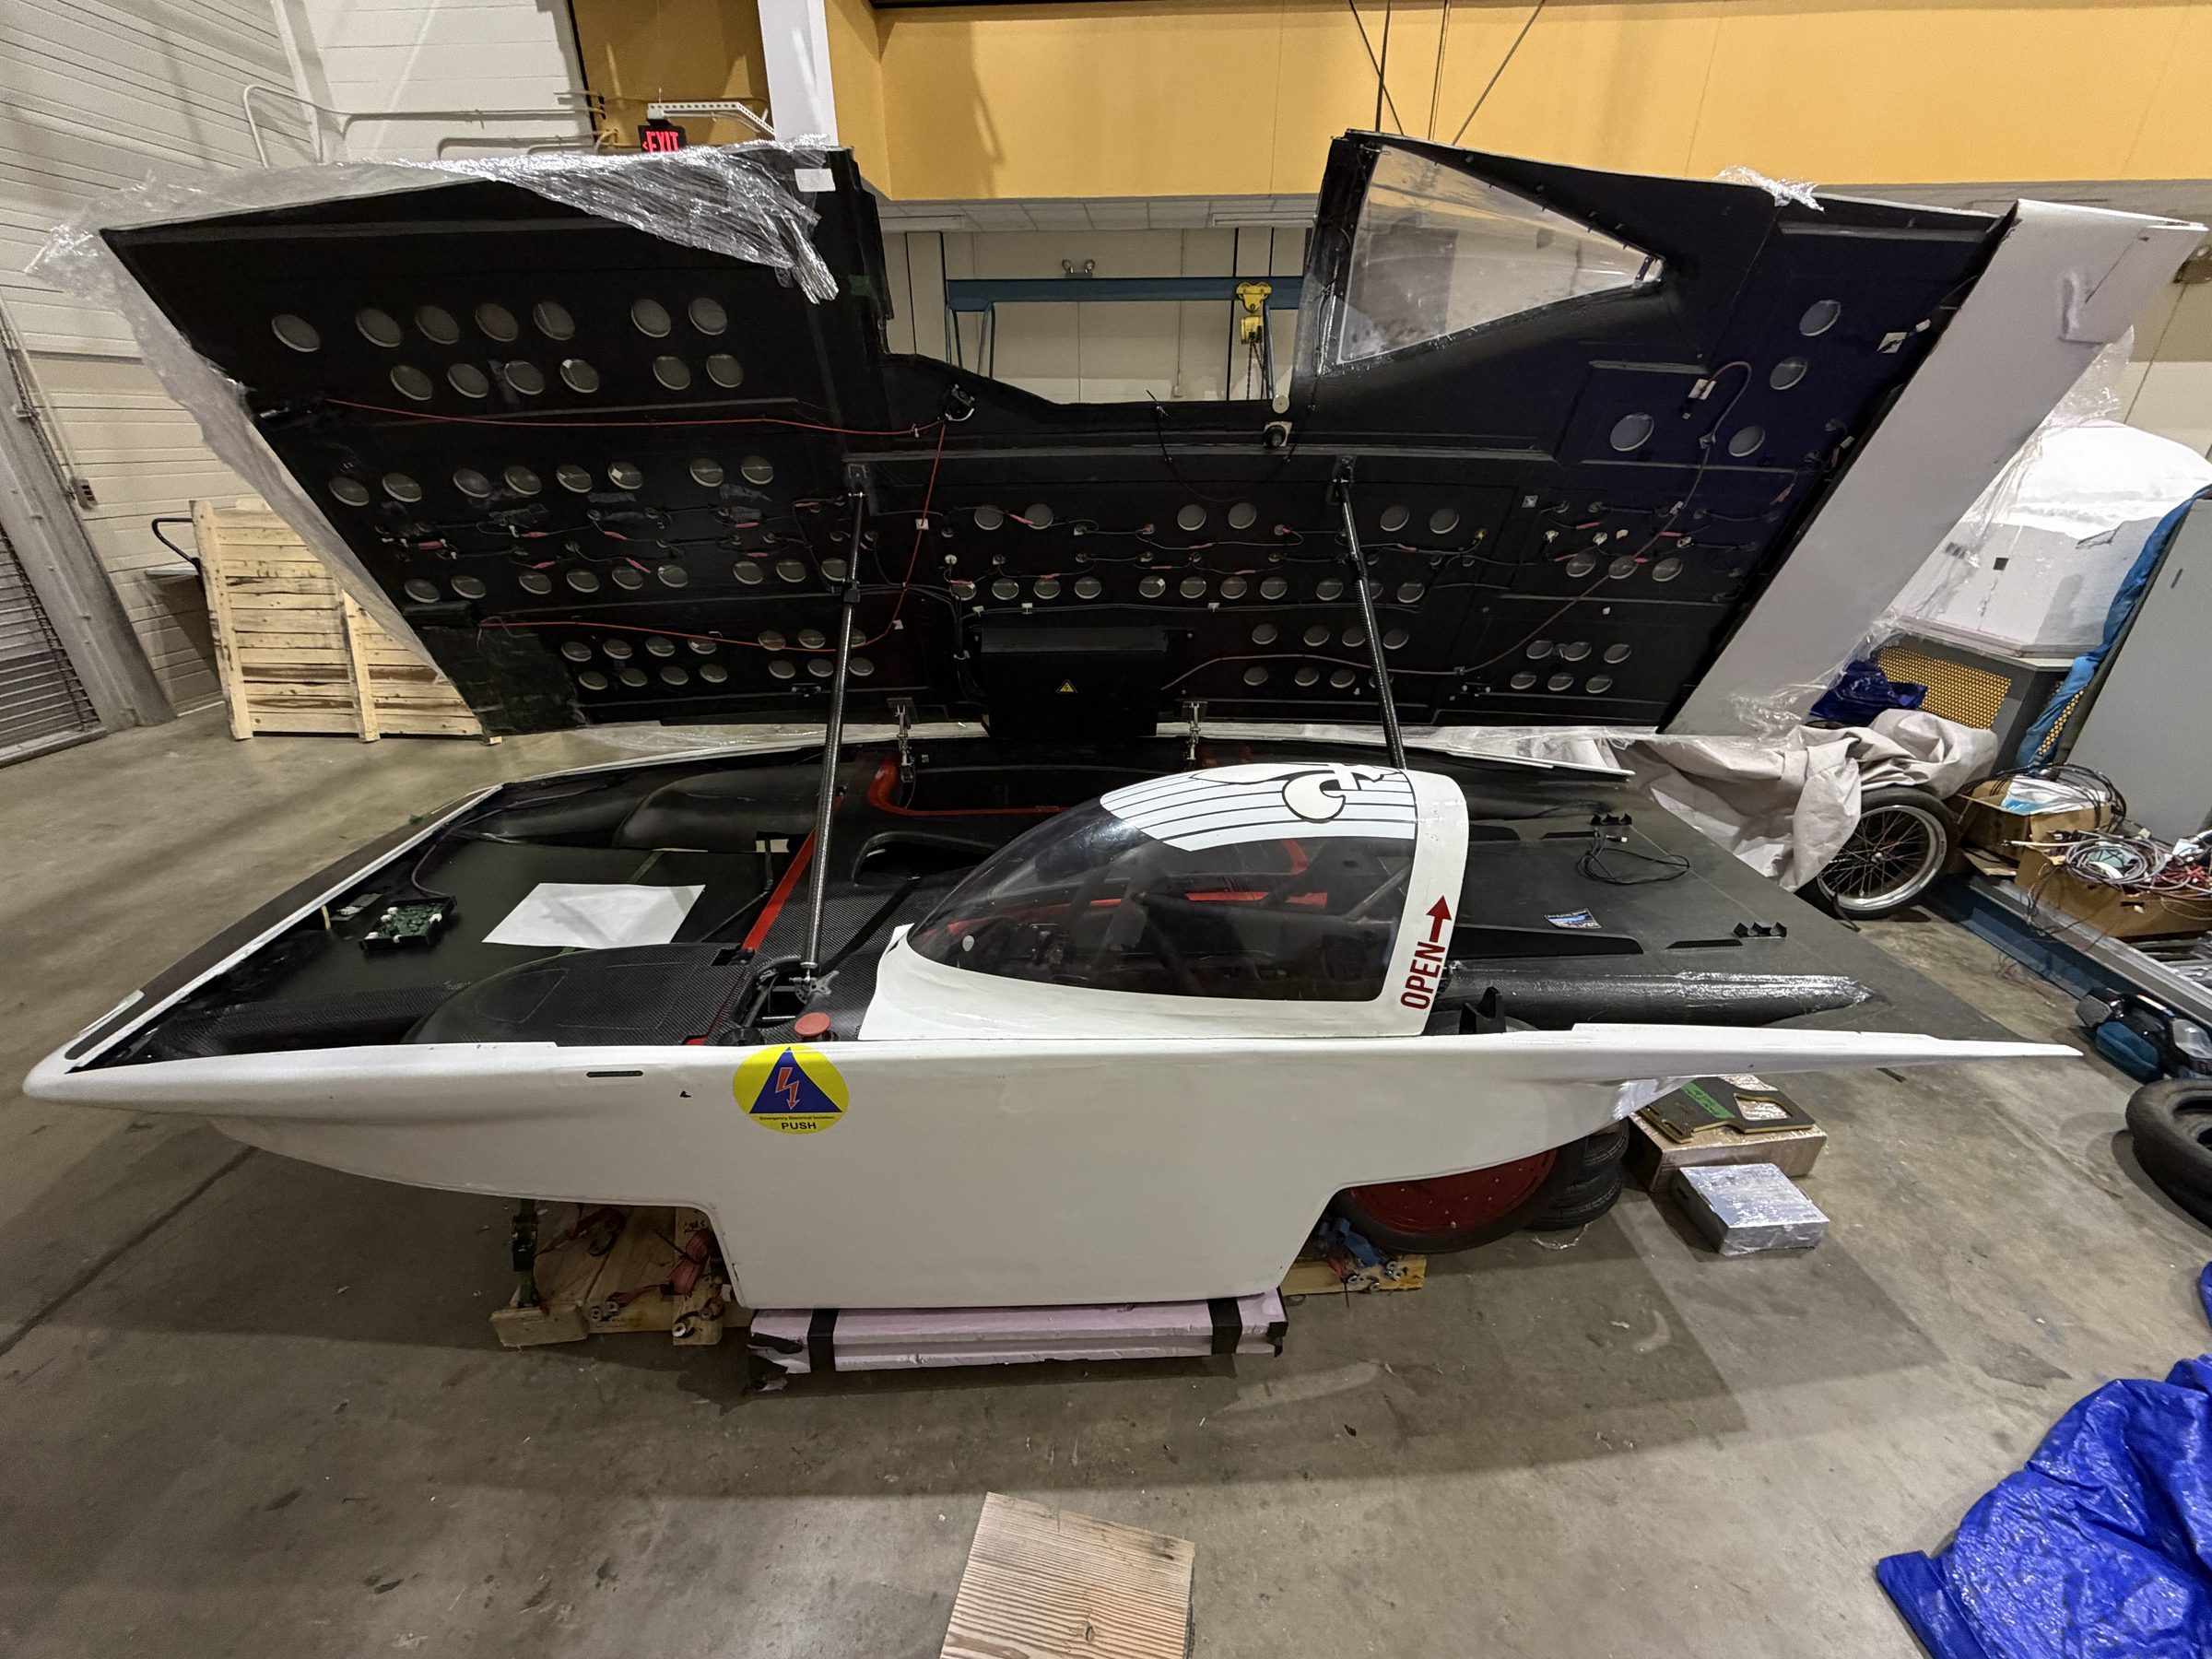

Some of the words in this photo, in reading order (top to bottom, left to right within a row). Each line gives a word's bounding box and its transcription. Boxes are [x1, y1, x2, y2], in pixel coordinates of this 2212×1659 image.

[646, 131, 678, 153] EXIT
[1400, 941, 1446, 1010] OPEN
[781, 1122, 817, 1130] PUSH
